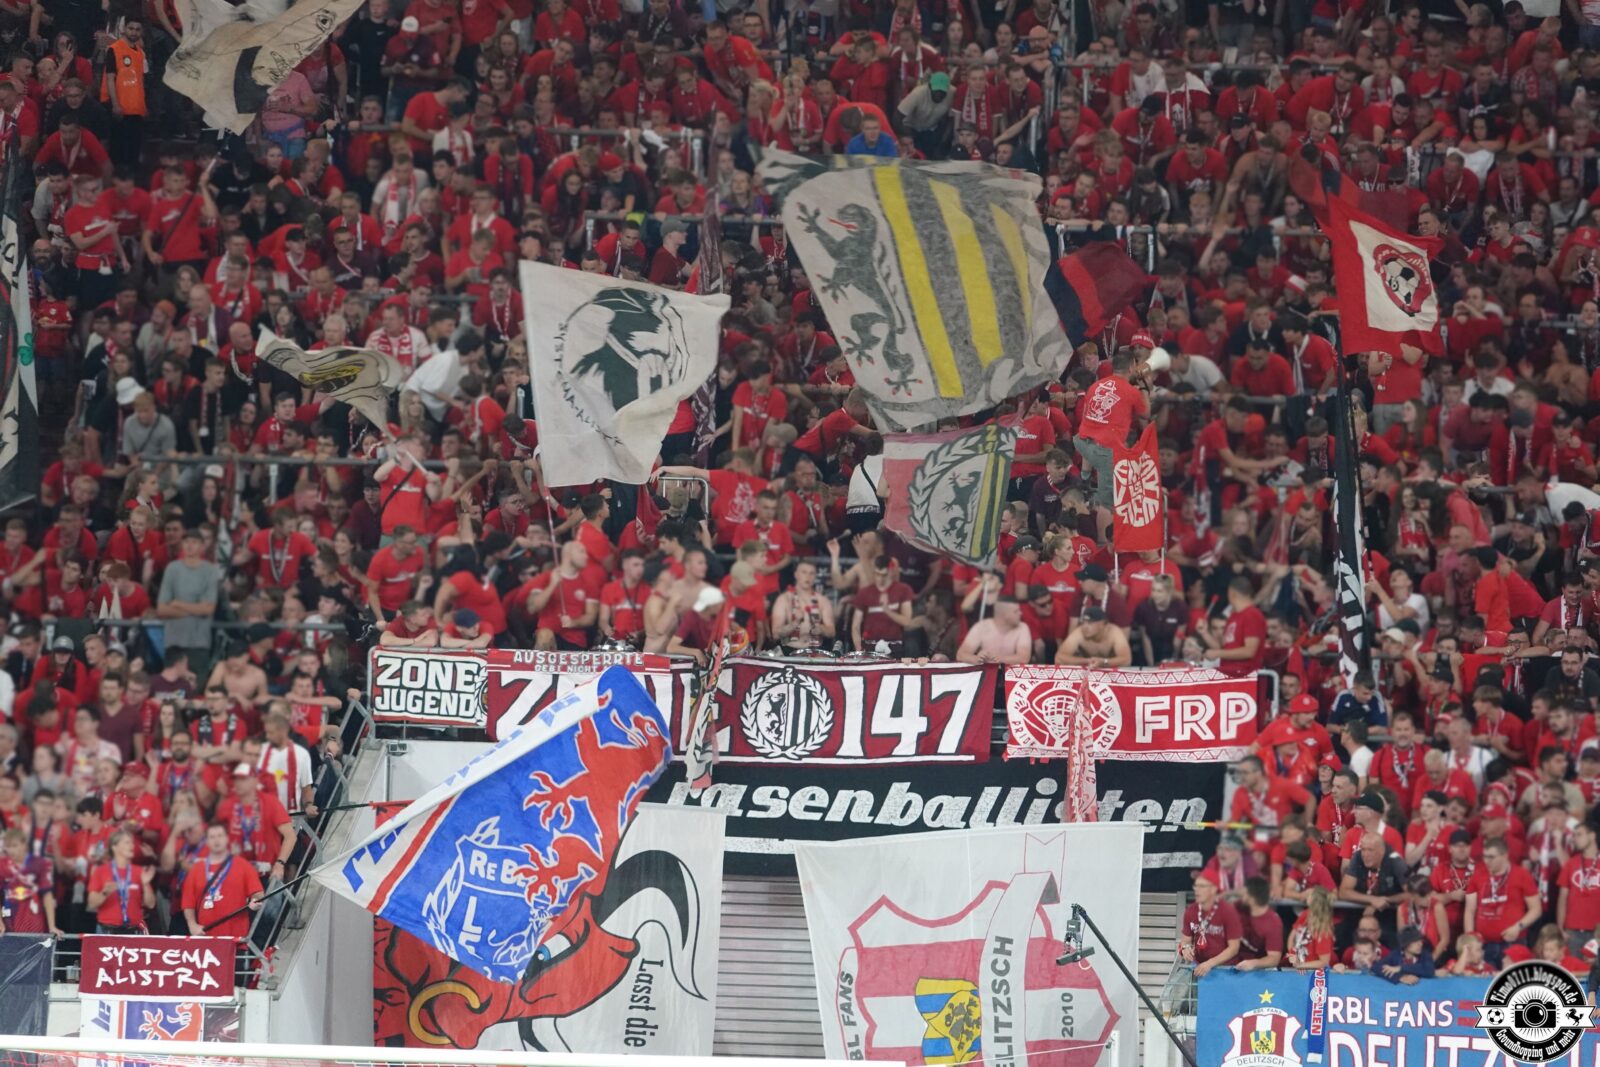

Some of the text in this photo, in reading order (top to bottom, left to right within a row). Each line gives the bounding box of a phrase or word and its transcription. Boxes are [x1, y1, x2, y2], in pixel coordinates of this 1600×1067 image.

[376, 655, 477, 692] ZONE
[513, 651, 644, 665] AUSGESPERRTE
[374, 687, 476, 717] JUGEND
[836, 671, 983, 757] 147
[1135, 692, 1258, 743] FRP
[1098, 724, 1117, 748] 2010
[667, 778, 1207, 832] rasenballiten
[99, 945, 221, 969] SYSTEMA
[95, 967, 219, 991] ALISTRA
[623, 958, 664, 1048] Lasst die
[839, 970, 857, 1027] FANS
[1061, 992, 1074, 1038] 2010
[1327, 996, 1453, 1028] RBL FANS
[1236, 1055, 1285, 1066] DELITZSCH
